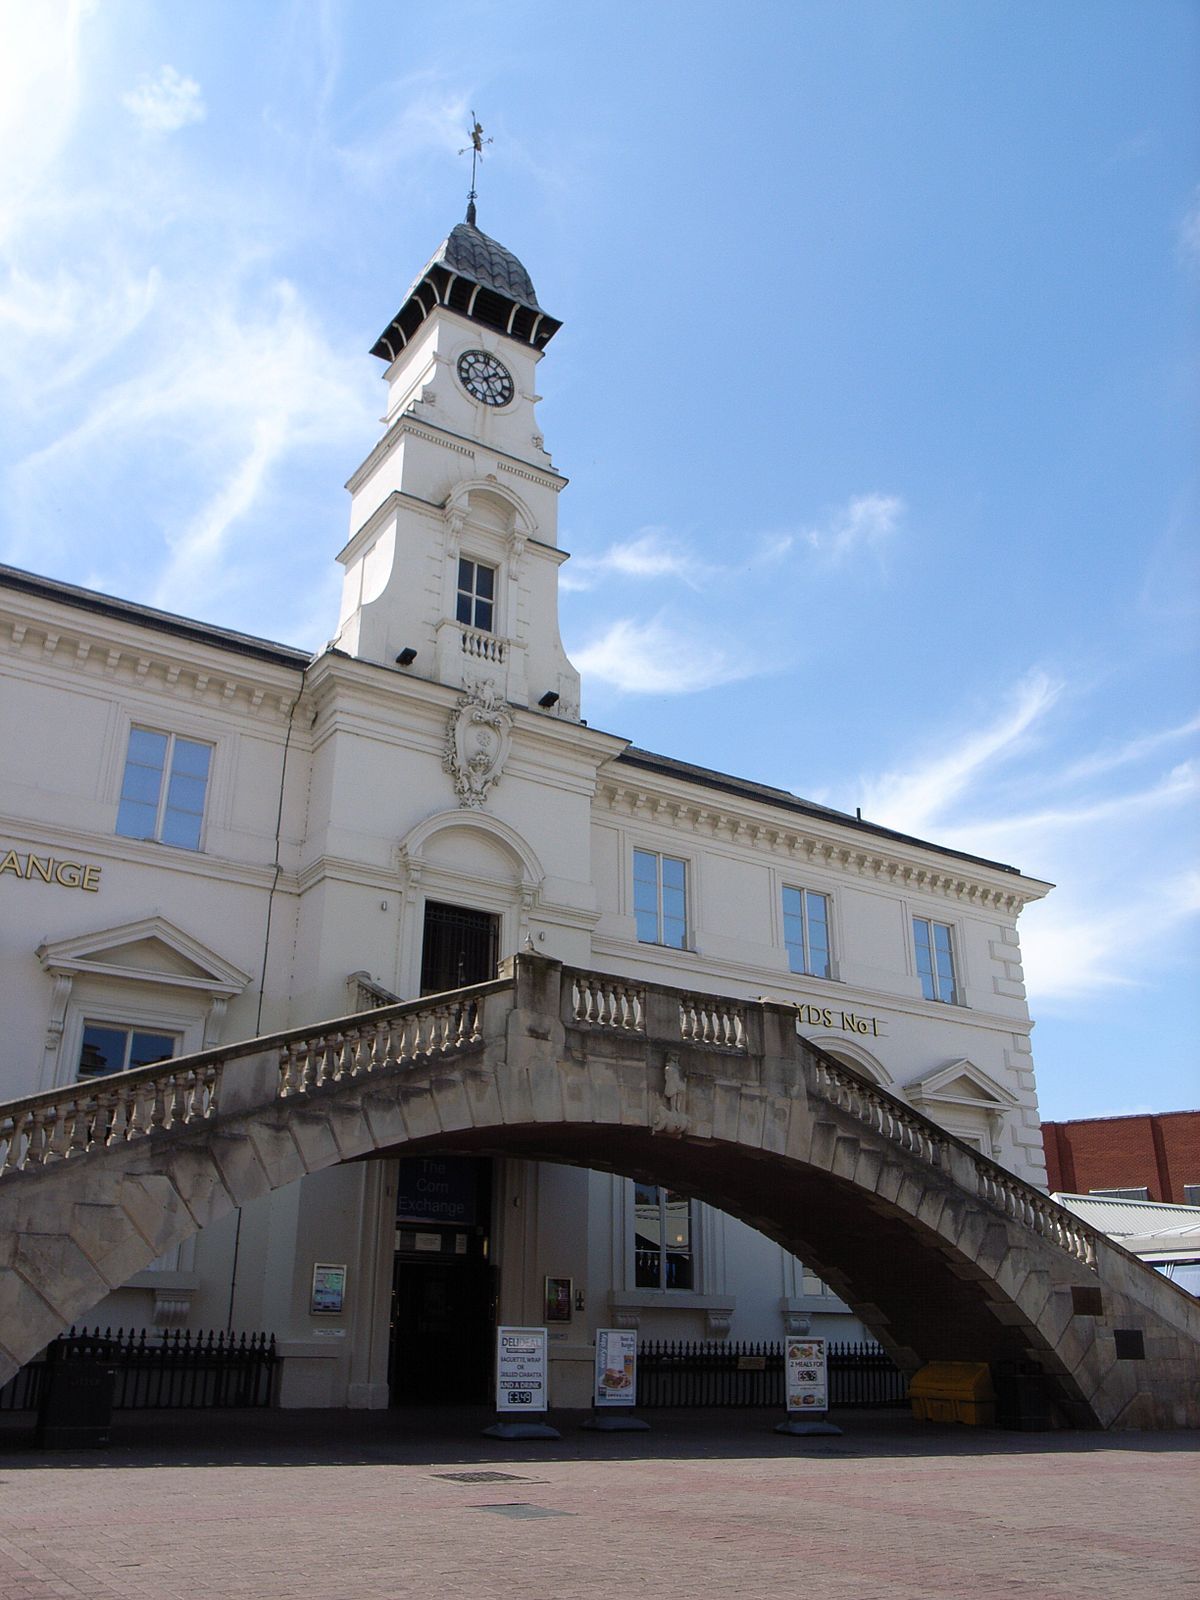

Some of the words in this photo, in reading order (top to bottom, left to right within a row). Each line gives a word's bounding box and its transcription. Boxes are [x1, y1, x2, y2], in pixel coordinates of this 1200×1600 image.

[0, 849, 102, 893] ANGE
[841, 1011, 868, 1034] No
[422, 1159, 446, 1174] The
[399, 1195, 465, 1217] Exchange
